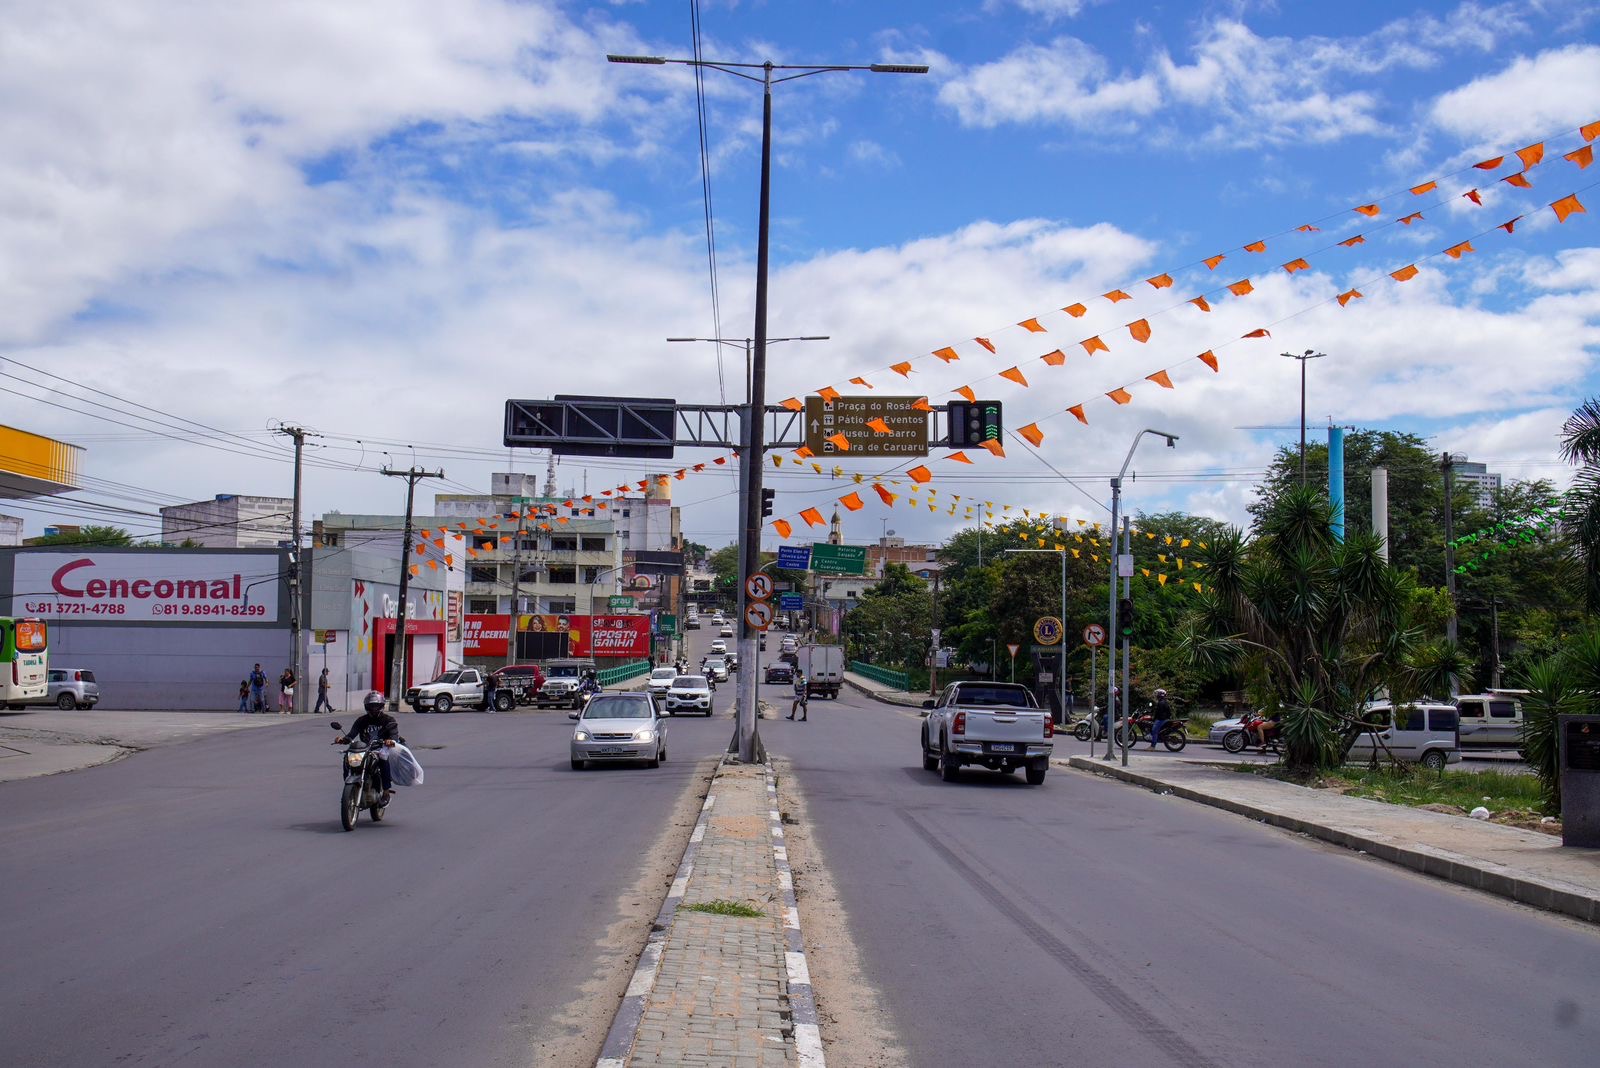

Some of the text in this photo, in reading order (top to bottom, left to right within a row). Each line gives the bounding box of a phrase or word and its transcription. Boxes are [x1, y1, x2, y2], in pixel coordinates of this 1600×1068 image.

[838, 402, 866, 412] Praça
[870, 401, 882, 410] do
[838, 414, 864, 424] Pátio
[884, 415, 924, 424] Eventos
[868, 443, 879, 451] de
[883, 443, 924, 451] Caruaru
[51, 558, 242, 600] Cencomal
[383, 593, 417, 619] Cenal
[611, 597, 631, 606] grau
[38, 603, 125, 614] 81 3721-4788
[163, 604, 266, 616] 81 9.8941-8299
[471, 620, 483, 630] NO
[1044, 625, 1052, 635] L
[592, 630, 638, 639] APOSTA
[594, 638, 635, 648] GANHA
